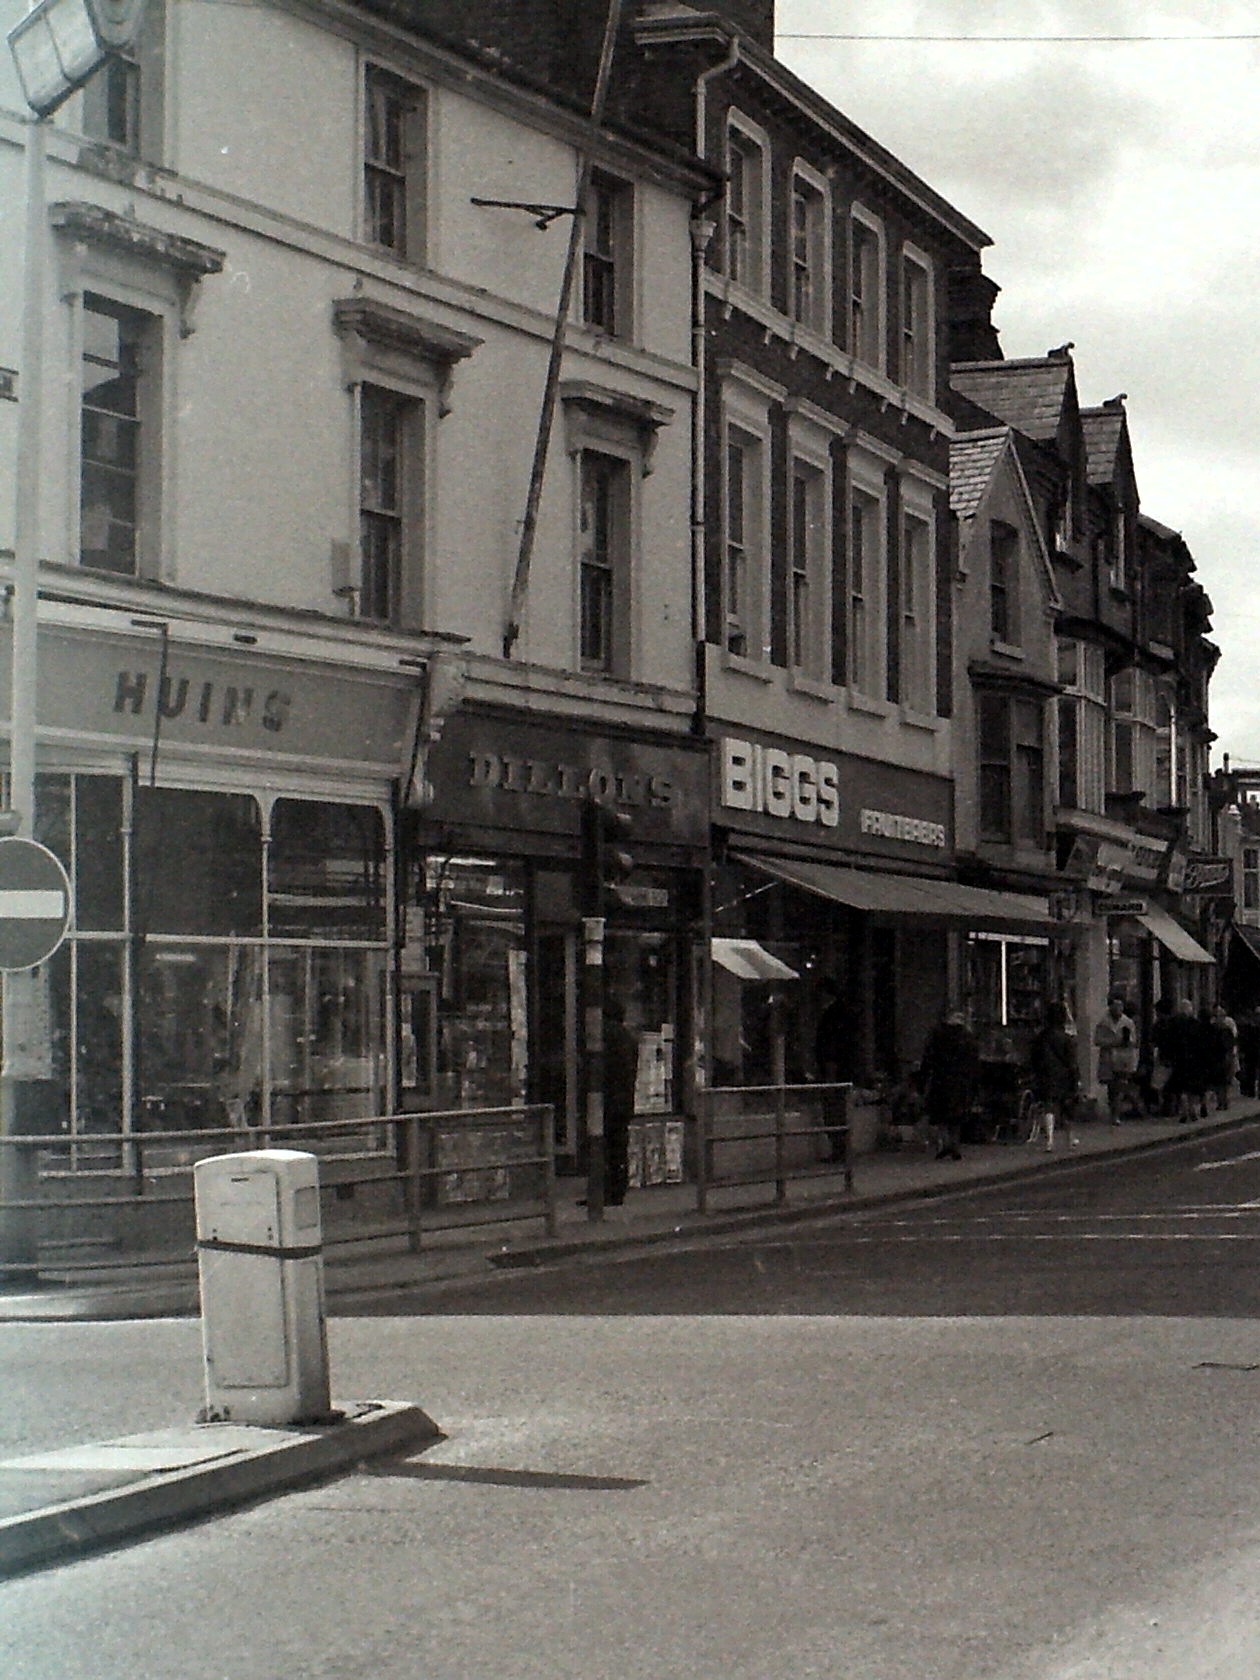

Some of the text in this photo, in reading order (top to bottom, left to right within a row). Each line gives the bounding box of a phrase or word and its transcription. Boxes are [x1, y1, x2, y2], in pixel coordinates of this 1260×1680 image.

[113, 671, 291, 732] HUINS
[469, 751, 673, 808] DILLONS
[721, 737, 840, 827] BIGGS
